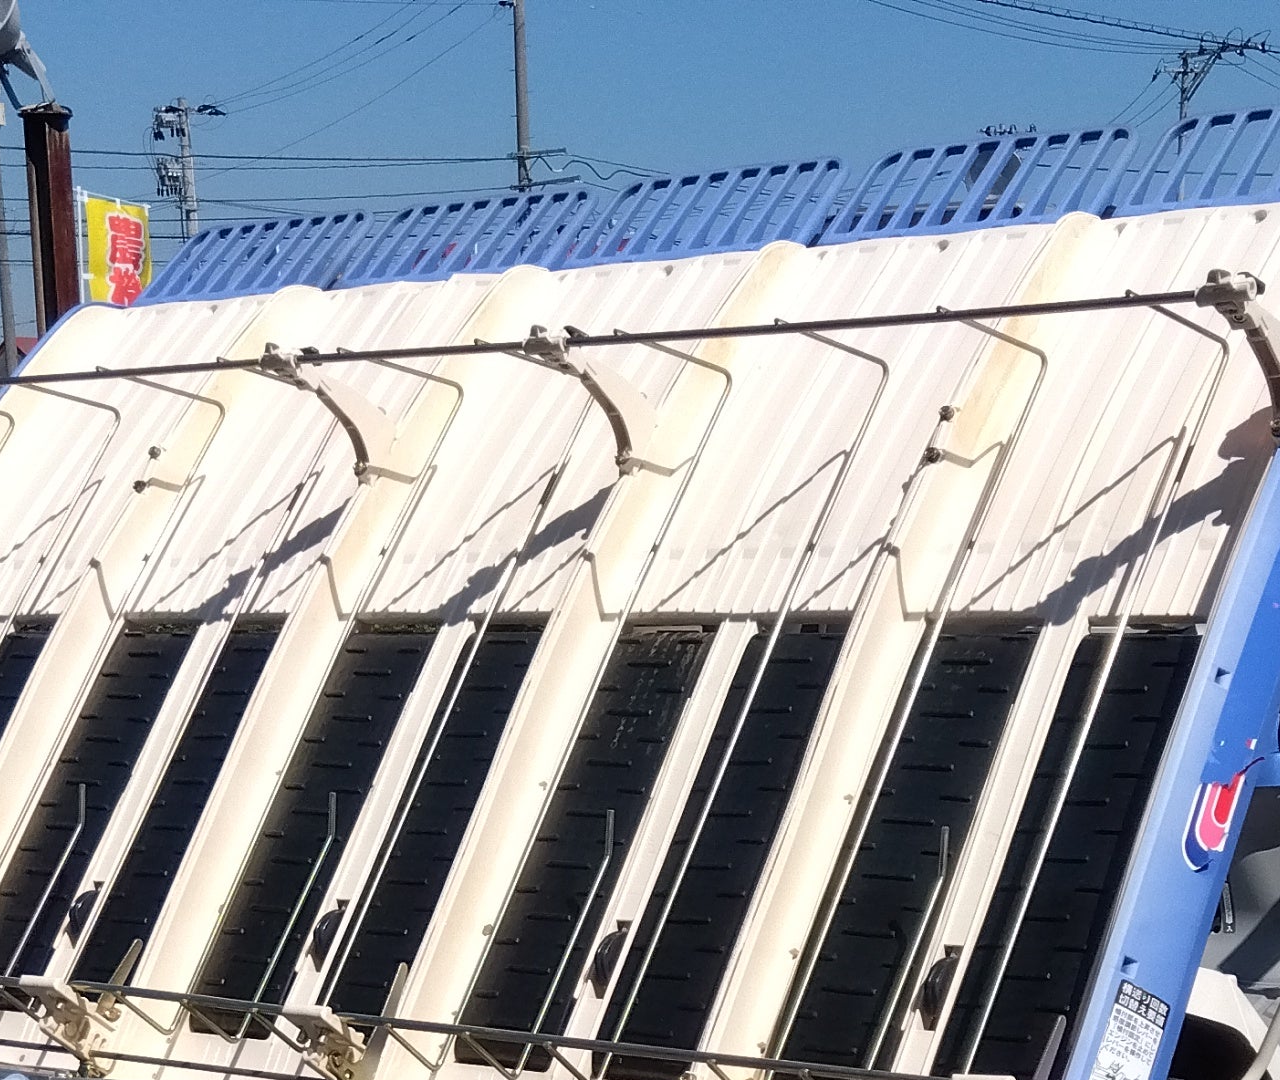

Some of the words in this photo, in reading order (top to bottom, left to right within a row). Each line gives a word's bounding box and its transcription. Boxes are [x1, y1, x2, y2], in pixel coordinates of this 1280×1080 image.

[1122, 983, 1168, 1016] 横送り回数
